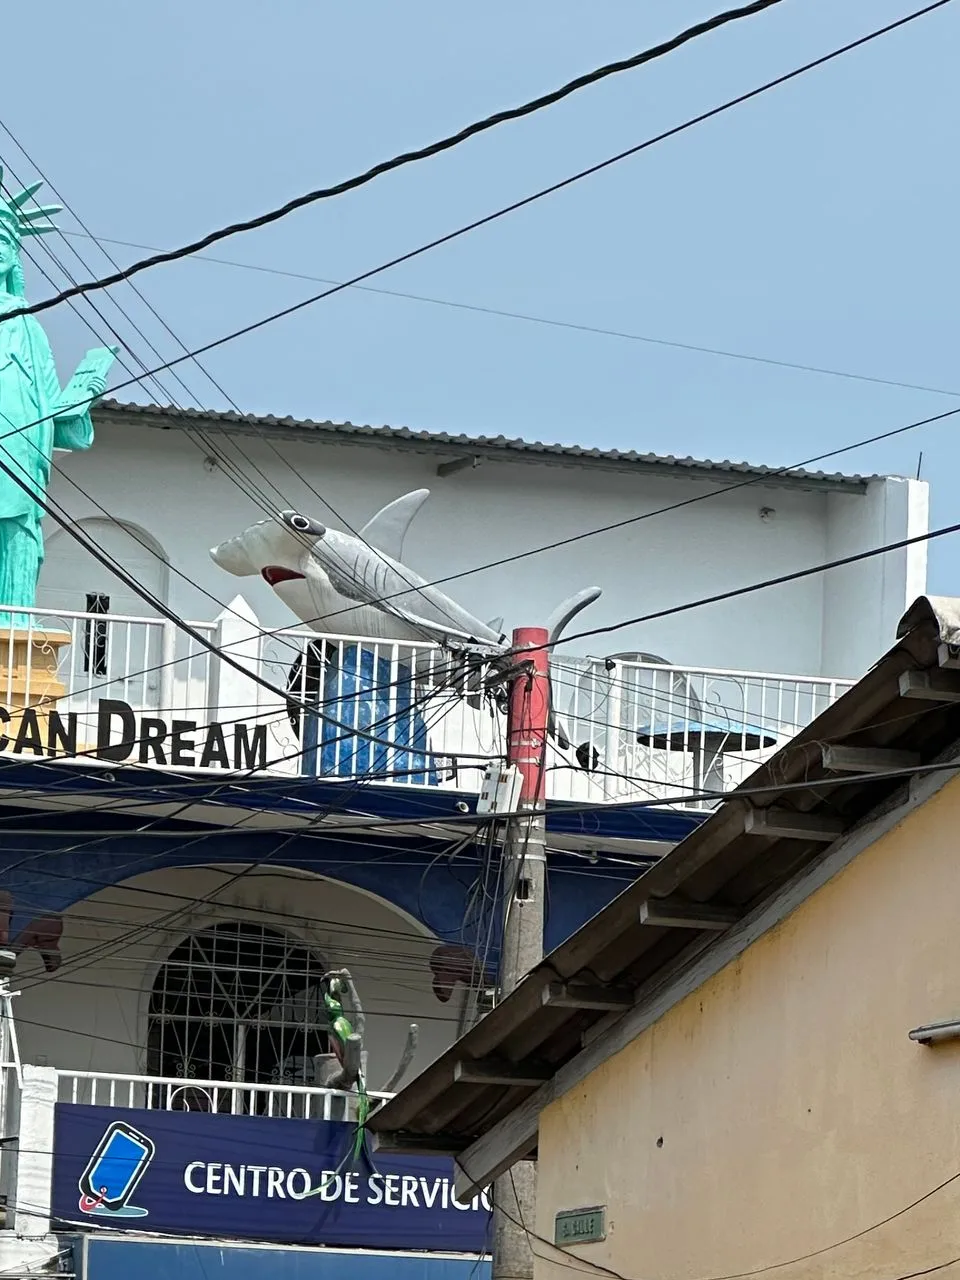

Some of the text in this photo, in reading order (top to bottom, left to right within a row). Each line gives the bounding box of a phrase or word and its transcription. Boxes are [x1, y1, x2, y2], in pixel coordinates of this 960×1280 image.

[98, 698, 268, 771] DREAM
[184, 1161, 312, 1200] CENTRO
[320, 1170, 360, 1203] DE
